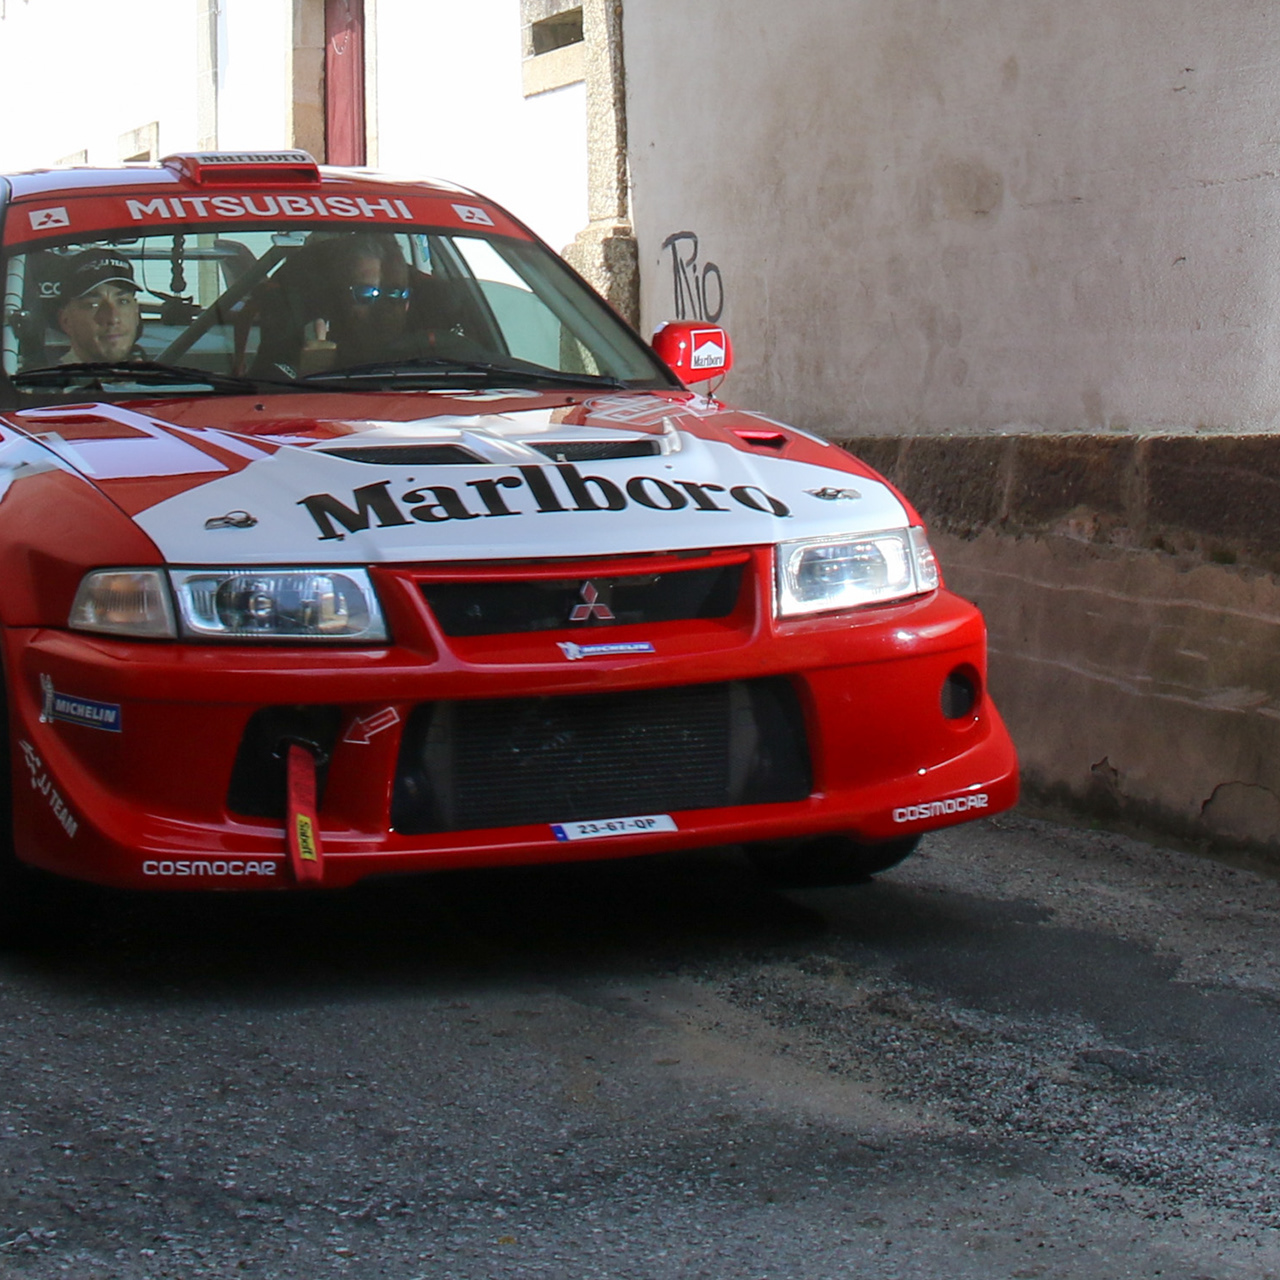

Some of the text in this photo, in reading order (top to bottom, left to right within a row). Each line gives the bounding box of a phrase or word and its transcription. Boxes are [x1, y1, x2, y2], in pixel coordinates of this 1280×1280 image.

[203, 154, 306, 163] Marlboro
[125, 195, 414, 220] MITSUBISHI
[693, 355, 722, 367] Marlboro
[296, 464, 793, 541] Marlboro
[583, 644, 649, 653] MICHELIN
[55, 699, 117, 723] MICHELIN
[49, 789, 79, 838] TEAM
[893, 793, 988, 823] COSMOCAR
[577, 818, 656, 834] 23-67-QP
[143, 860, 276, 876] COSMOCAR
